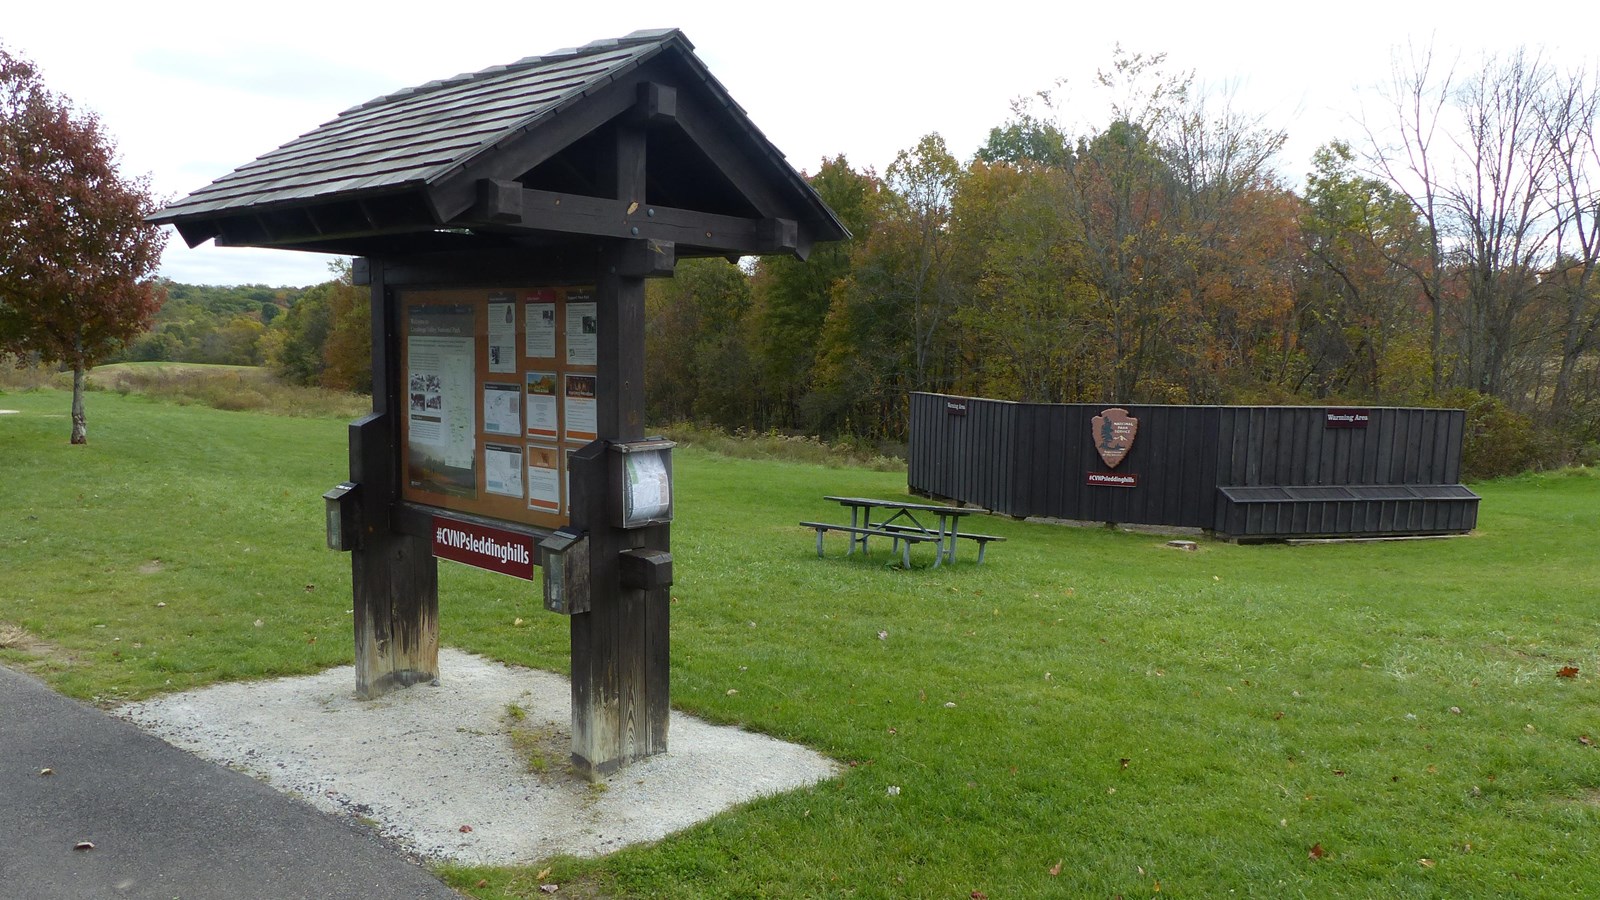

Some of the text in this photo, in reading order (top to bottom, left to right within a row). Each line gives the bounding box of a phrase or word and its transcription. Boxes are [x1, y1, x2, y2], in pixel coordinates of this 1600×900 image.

[1327, 414, 1354, 422] Warming
[1089, 474, 1134, 484] #CVNPsleddinghills
[436, 527, 530, 565] #CVNPsleddinghills
